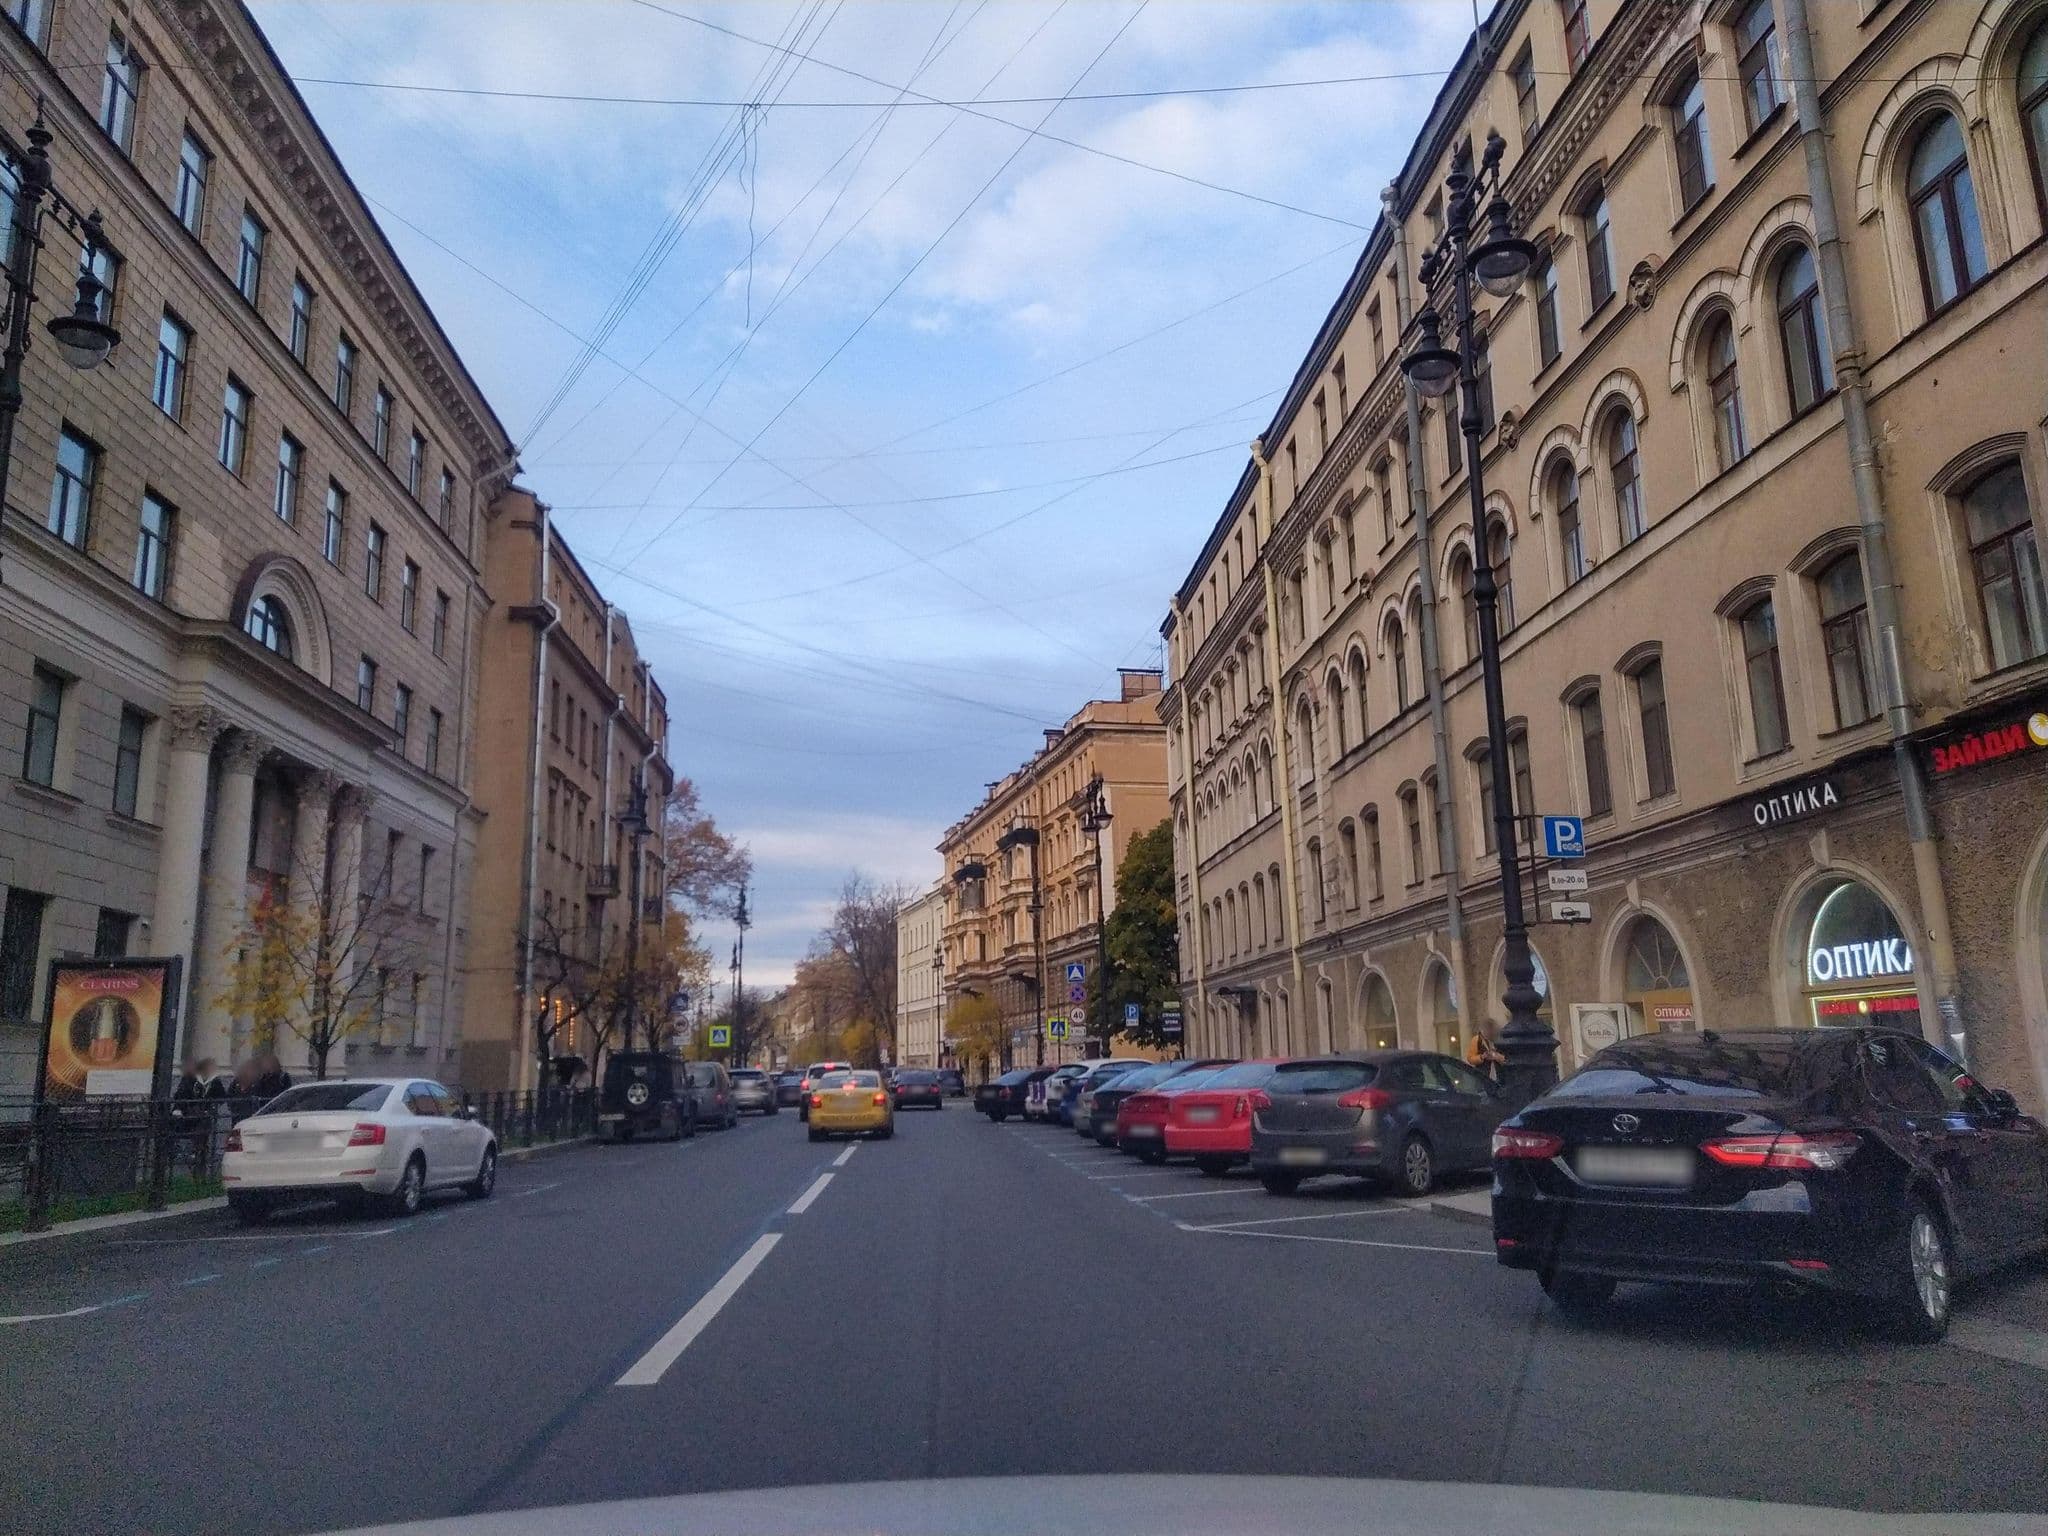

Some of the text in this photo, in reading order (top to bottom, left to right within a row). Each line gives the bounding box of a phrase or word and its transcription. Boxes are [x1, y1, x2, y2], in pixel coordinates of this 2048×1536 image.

[1931, 723, 2026, 773] ЗАЙДИ
[1754, 782, 1838, 825] ОПТИКА
[1554, 821, 1576, 852] P
[1073, 1010, 1084, 1021] 40
[1653, 1007, 1692, 1018] ОПТИКА
